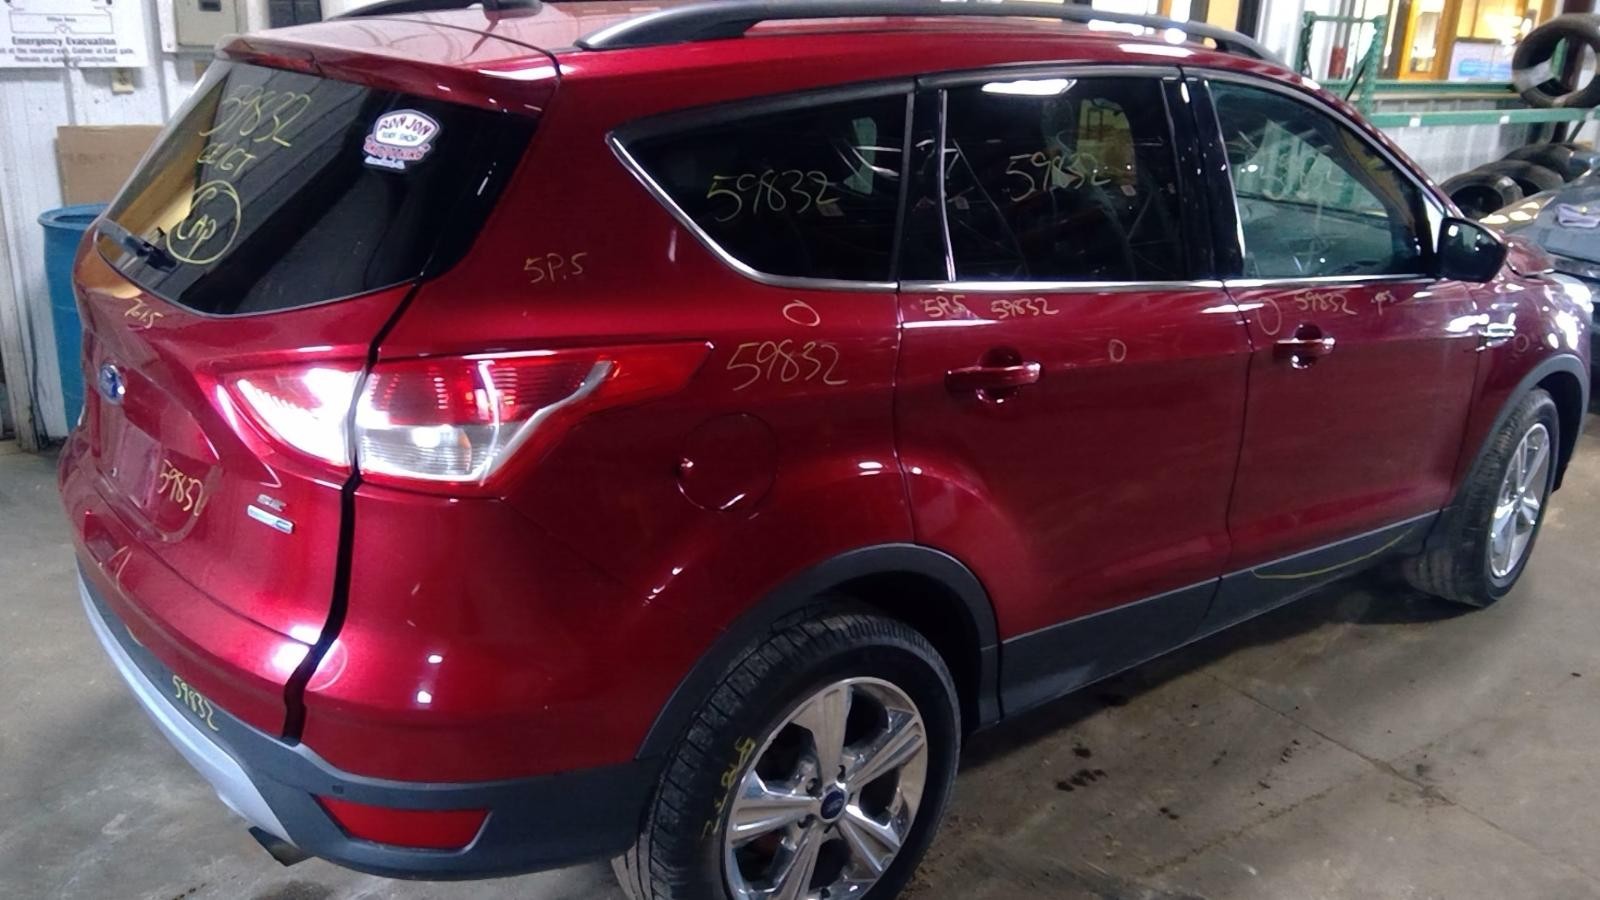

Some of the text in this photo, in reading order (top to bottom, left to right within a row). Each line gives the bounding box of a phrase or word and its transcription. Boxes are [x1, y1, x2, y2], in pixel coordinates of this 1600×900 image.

[12, 36, 117, 47] Emergency Evacuation
[405, 118, 432, 136] JON
[706, 168, 841, 222] 59832
[990, 297, 1060, 319] 59832
[726, 338, 849, 391] 59832
[172, 674, 219, 731] 59832
